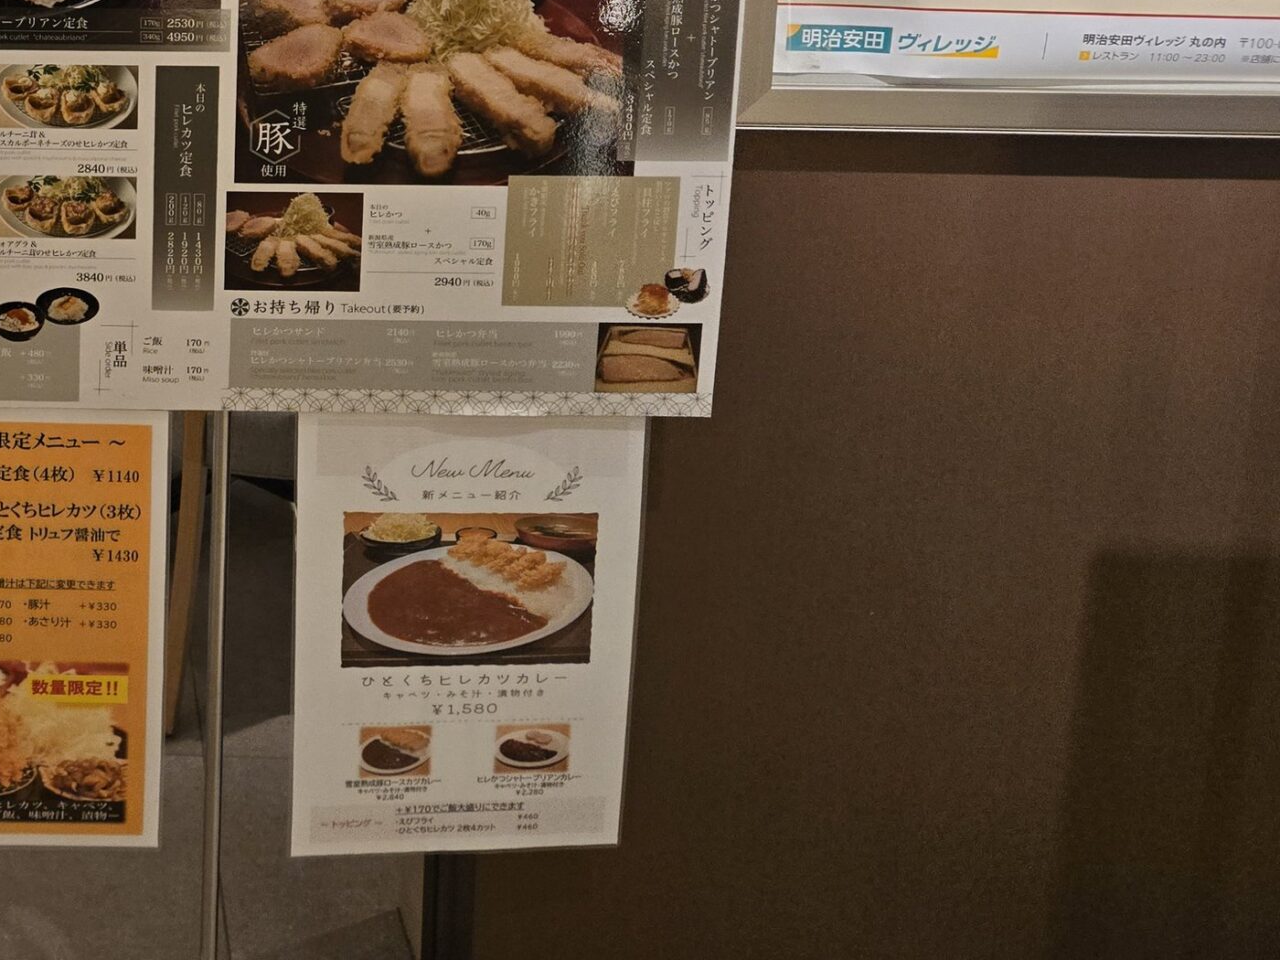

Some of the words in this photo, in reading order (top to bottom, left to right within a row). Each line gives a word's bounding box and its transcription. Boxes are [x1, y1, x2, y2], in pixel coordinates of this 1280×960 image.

[801, 28, 885, 50] 明治安田
[898, 33, 996, 54] ヴィレッジ
[1189, 36, 1226, 49] 丸の内
[1092, 52, 1139, 61] レストラン
[292, 101, 307, 130] 特選
[179, 103, 193, 178] ヒレカツ定食
[256, 122, 294, 154] 豚
[261, 164, 286, 177] 使用
[700, 185, 714, 251] トッピング
[254, 300, 335, 314] お持ち帰り
[113, 341, 127, 367] 単品
[411, 457, 464, 478] New
[469, 459, 535, 478] Menu
[92, 470, 140, 483] ¥1140
[422, 490, 521, 500] 新メニュー紹介
[92, 549, 139, 562] ¥1430
[361, 673, 567, 687] ひとくちヒレカツカレー
[432, 703, 498, 715] ¥1,580
